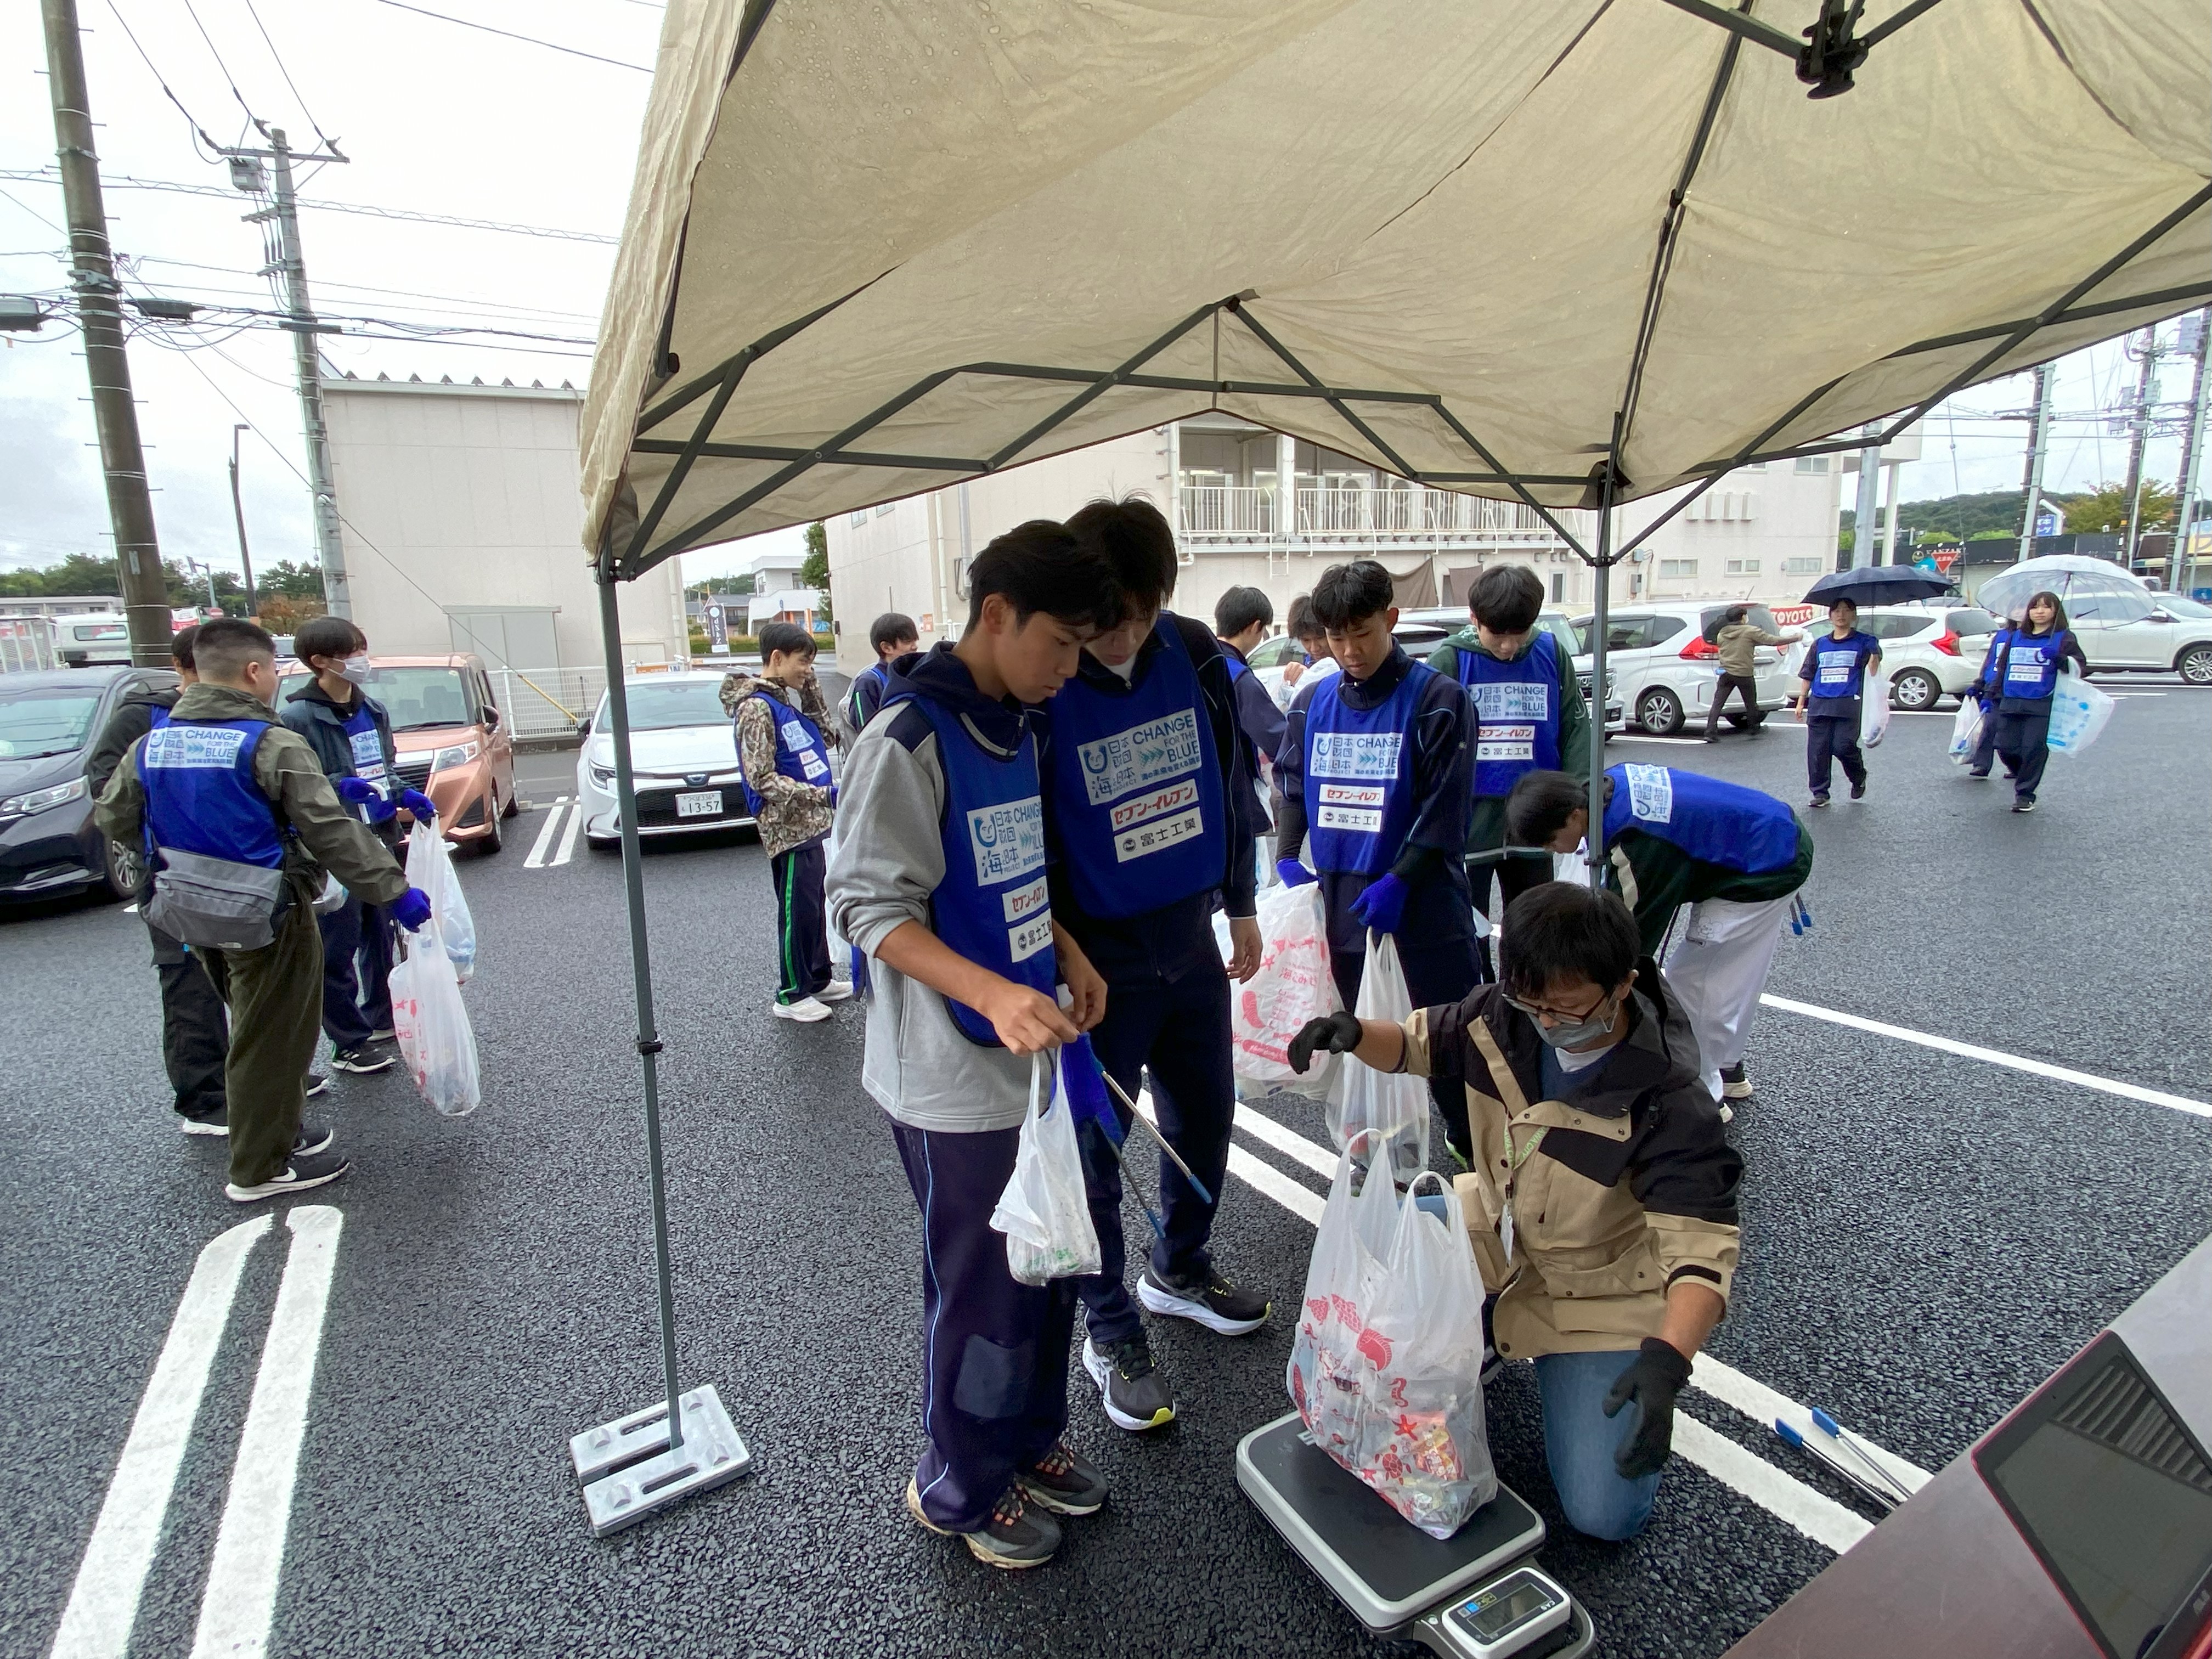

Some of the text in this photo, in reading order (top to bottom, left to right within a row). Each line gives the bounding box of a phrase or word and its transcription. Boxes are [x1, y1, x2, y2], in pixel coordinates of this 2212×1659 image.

[1771, 608, 1812, 624] TOYOTA
[1504, 686, 1545, 695] CHANGE
[1521, 702, 1545, 712] BLUE
[185, 730, 242, 741] CHANGE
[1132, 714, 1194, 745] CHANGE
[356, 732, 379, 742] CHAN
[1164, 729, 1197, 748] FOR THE
[1333, 737, 1353, 747] 日本
[1356, 737, 1401, 748] CHANGE
[1108, 736, 1130, 754] 日本
[1166, 739, 1200, 763] BLUE
[205, 747, 235, 758] BLUE
[1378, 757, 1398, 769] BUE
[689, 800, 719, 814] 13-57
[994, 809, 1013, 827] 日本
[1140, 817, 1197, 847] 富士工業
[1540, 1600, 1556, 1611] CAS
